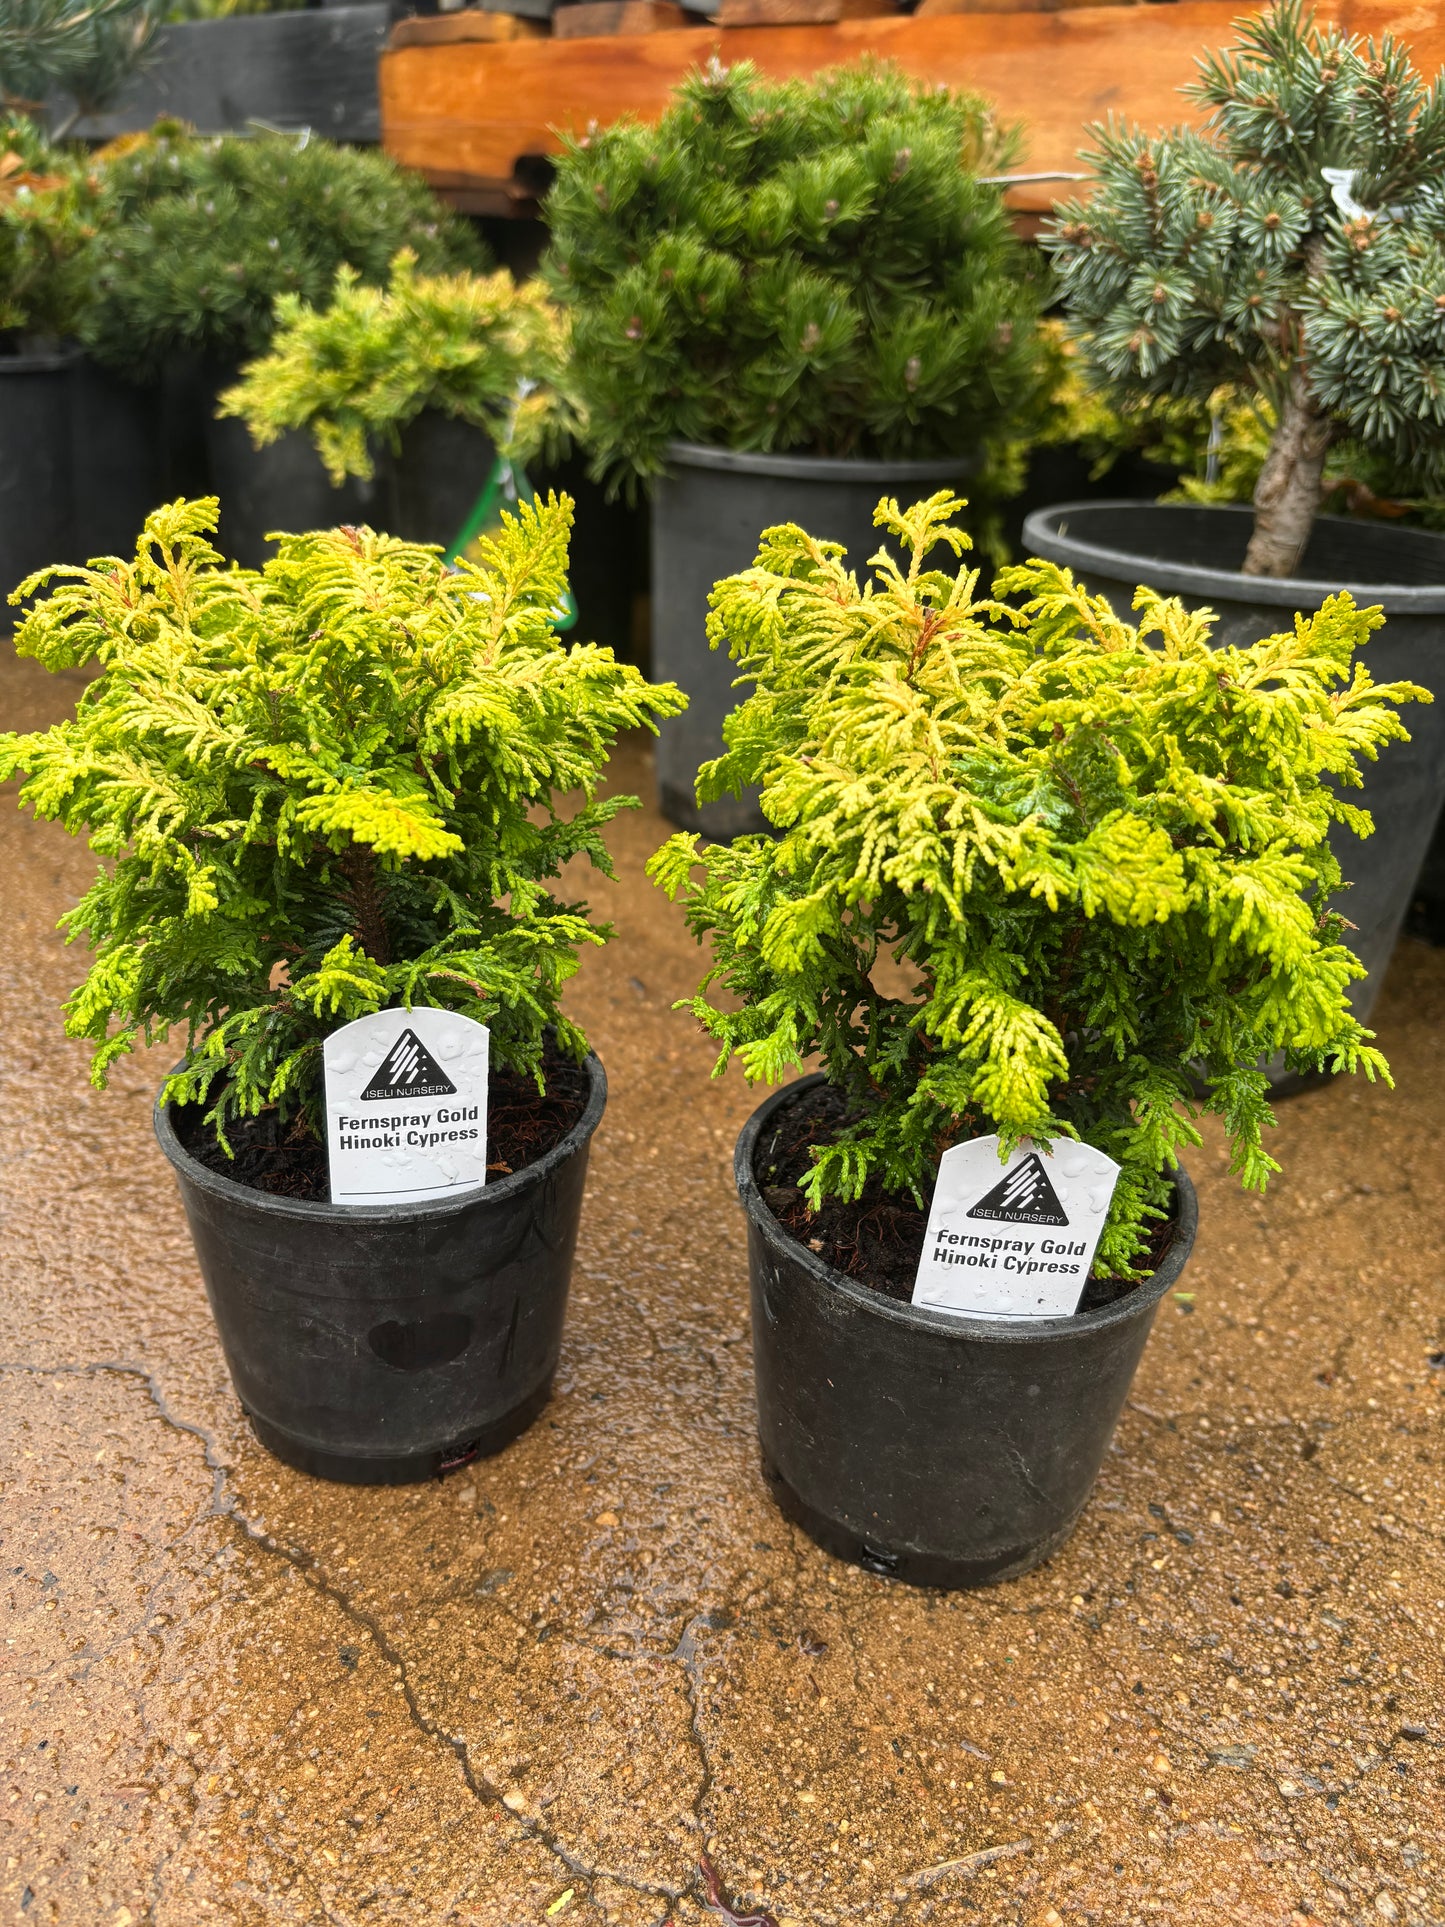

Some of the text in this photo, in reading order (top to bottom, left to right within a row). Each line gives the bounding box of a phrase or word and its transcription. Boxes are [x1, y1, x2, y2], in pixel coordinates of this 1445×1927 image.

[366, 1085, 450, 1098] ISELI NURSERY
[338, 1106, 479, 1131] Fernspray Gold
[340, 1128, 479, 1150] Hinoki Cypress
[972, 1208, 1064, 1224] ISELI NURSERY
[936, 1229, 1087, 1256] Fernspray Gold
[933, 1248, 1081, 1275] Hinoki Cypress
